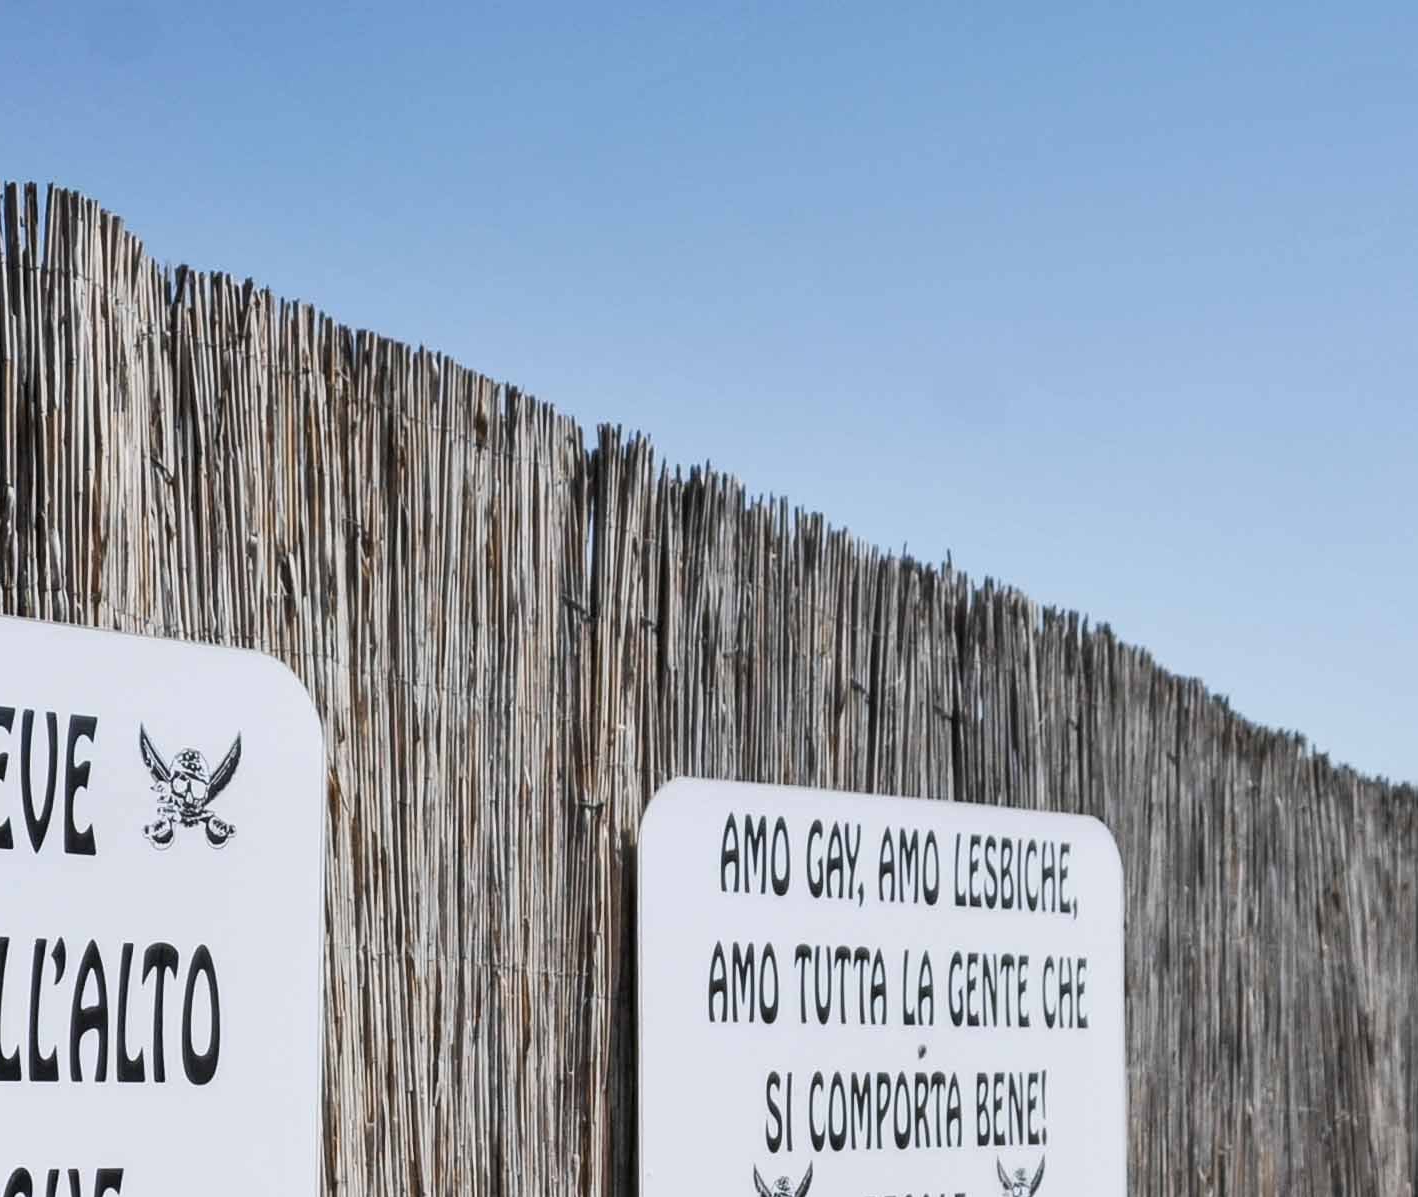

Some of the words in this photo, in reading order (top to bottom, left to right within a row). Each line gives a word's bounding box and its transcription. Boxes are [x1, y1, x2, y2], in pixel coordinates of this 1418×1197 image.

[719, 812, 792, 899] AMO
[805, 818, 866, 908] GAY,
[877, 826, 941, 907] AMO
[953, 832, 1080, 920] LESBICHE,
[707, 940, 780, 1026] AMO
[793, 943, 888, 1026] TUTTA
[901, 949, 935, 1027] LA
[947, 950, 1031, 1029] GENTE
[1041, 955, 1090, 1030] CHE
[764, 1070, 794, 1155] SI
[808, 1070, 963, 1154] COMPORTA
[975, 1069, 1048, 1148] BENE!
